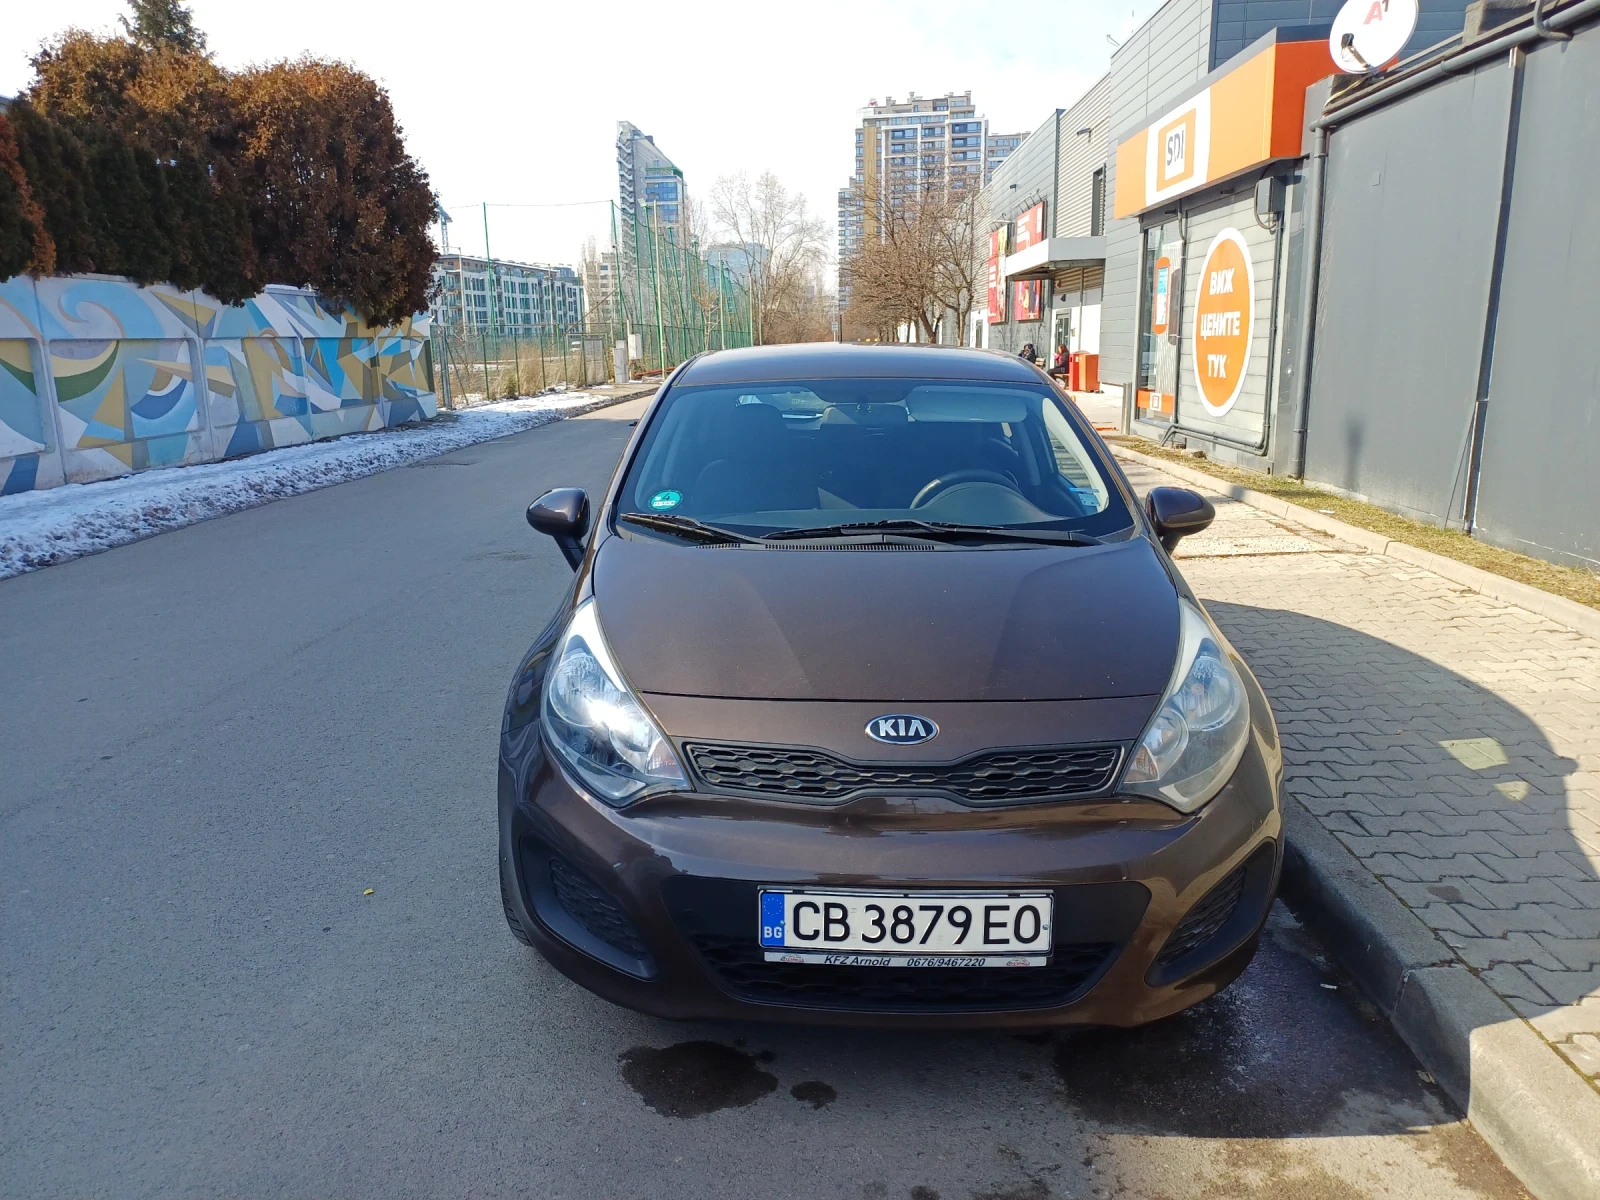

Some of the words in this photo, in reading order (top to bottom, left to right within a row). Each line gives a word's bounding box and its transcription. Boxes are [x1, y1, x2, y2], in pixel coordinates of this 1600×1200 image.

[1209, 268, 1235, 295] ВИЖ
[1200, 310, 1241, 341] ЦЕНИТЕ
[1207, 354, 1228, 379] ТУК
[878, 718, 927, 737] KIA
[763, 926, 783, 939] BG
[861, 904, 972, 945] 3879
[824, 955, 850, 965] KFZ
[850, 956, 892, 967] Arnold
[906, 957, 986, 967] 0676/9467220
